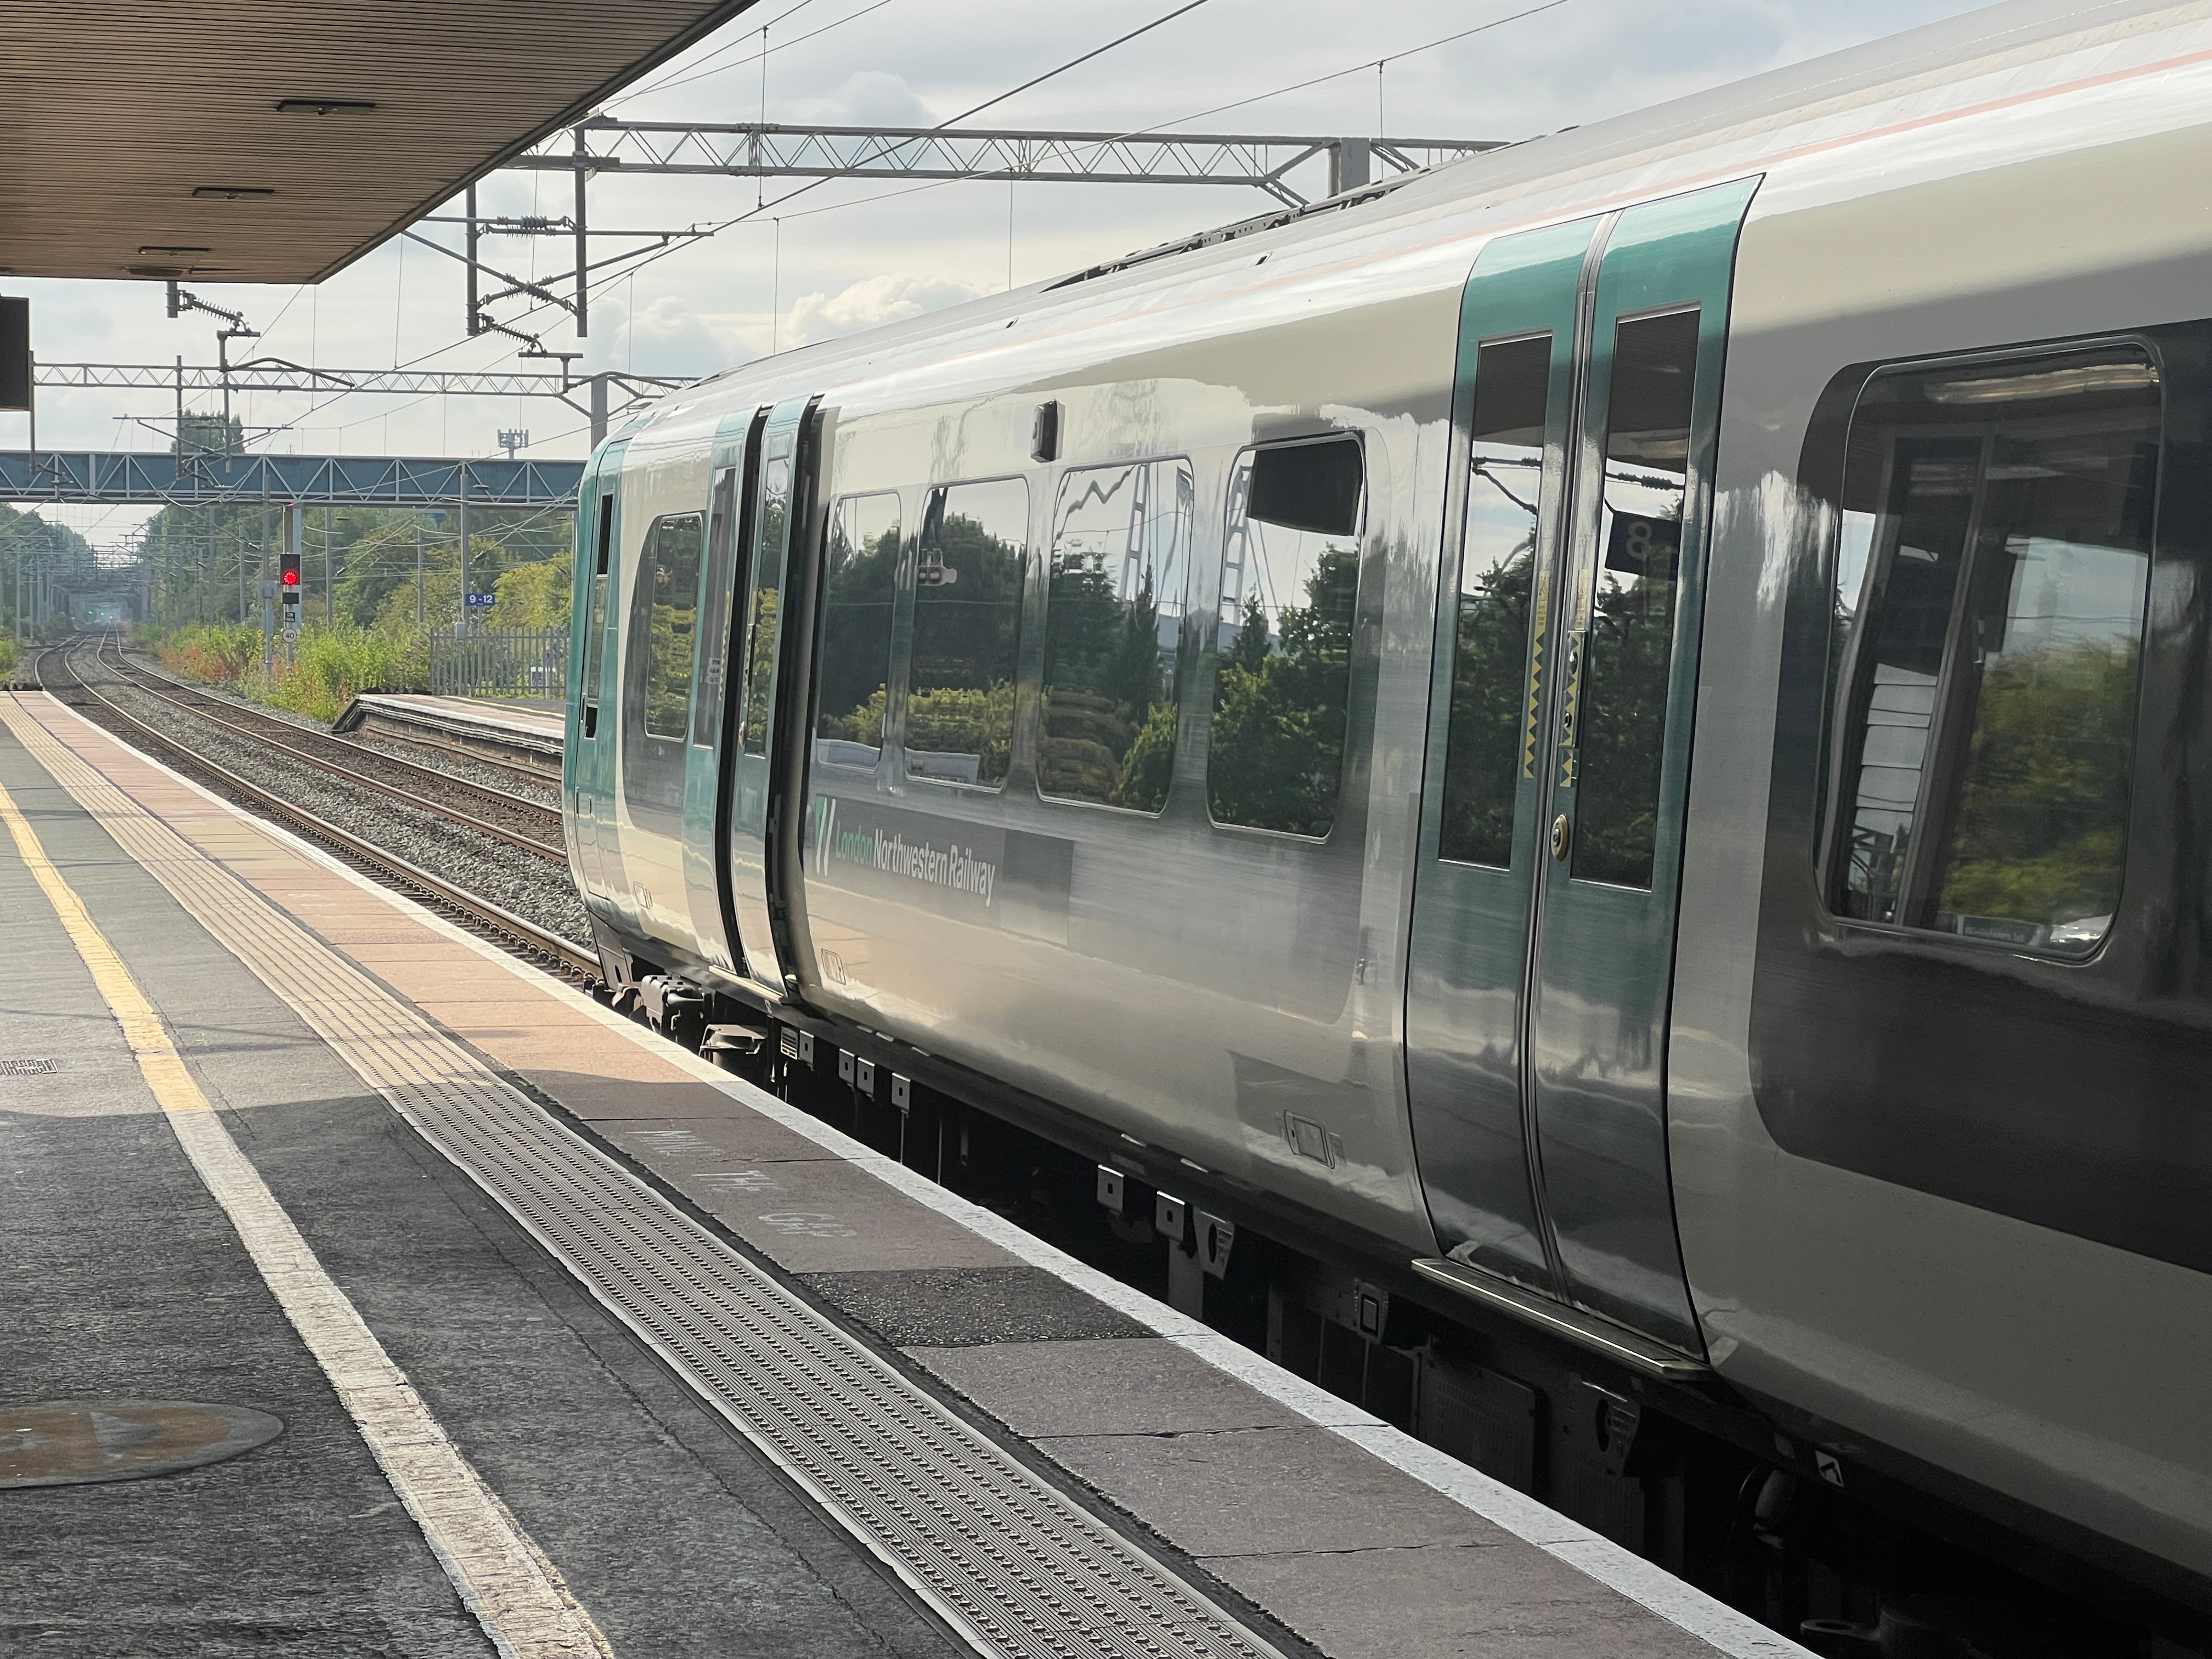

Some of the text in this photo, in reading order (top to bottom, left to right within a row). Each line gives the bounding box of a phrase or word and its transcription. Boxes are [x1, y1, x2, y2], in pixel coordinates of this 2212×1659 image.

[836, 821, 996, 907] London Northwestern Railway
